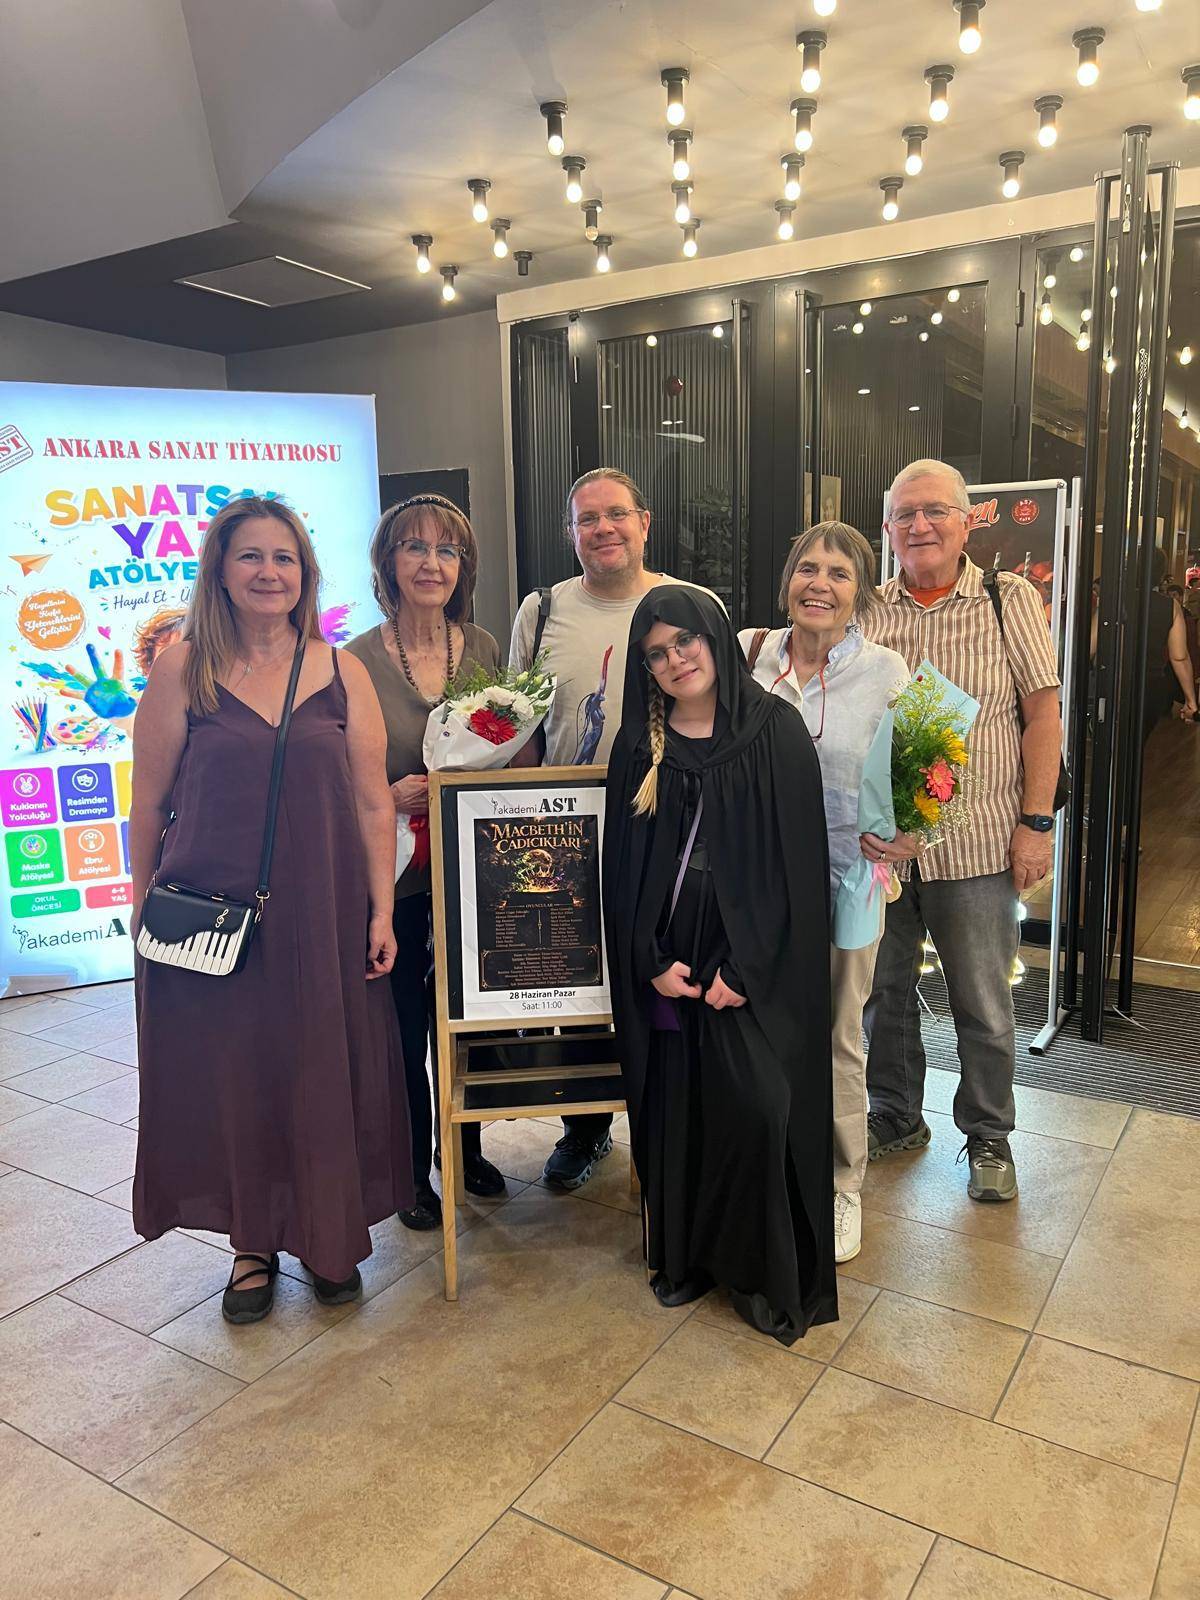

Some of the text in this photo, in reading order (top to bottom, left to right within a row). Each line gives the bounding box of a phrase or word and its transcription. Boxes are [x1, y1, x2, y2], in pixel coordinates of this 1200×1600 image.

[43, 437, 343, 462] ANKARA SANAT TİYATROSU
[113, 592, 150, 610] Hayal
[153, 590, 167, 604] Et
[10, 801, 48, 812] Kuklanın
[66, 796, 108, 807] Resimden
[498, 797, 577, 815] akademi AST
[8, 812, 51, 822] Yolculuğu
[69, 806, 108, 818] Dramaya
[31, 901, 62, 912] ÖNCESİ
[27, 926, 103, 950] akademi
[509, 989, 576, 1000] 28 Haziran Pazar
[522, 1001, 563, 1011] Saat: 11:00
